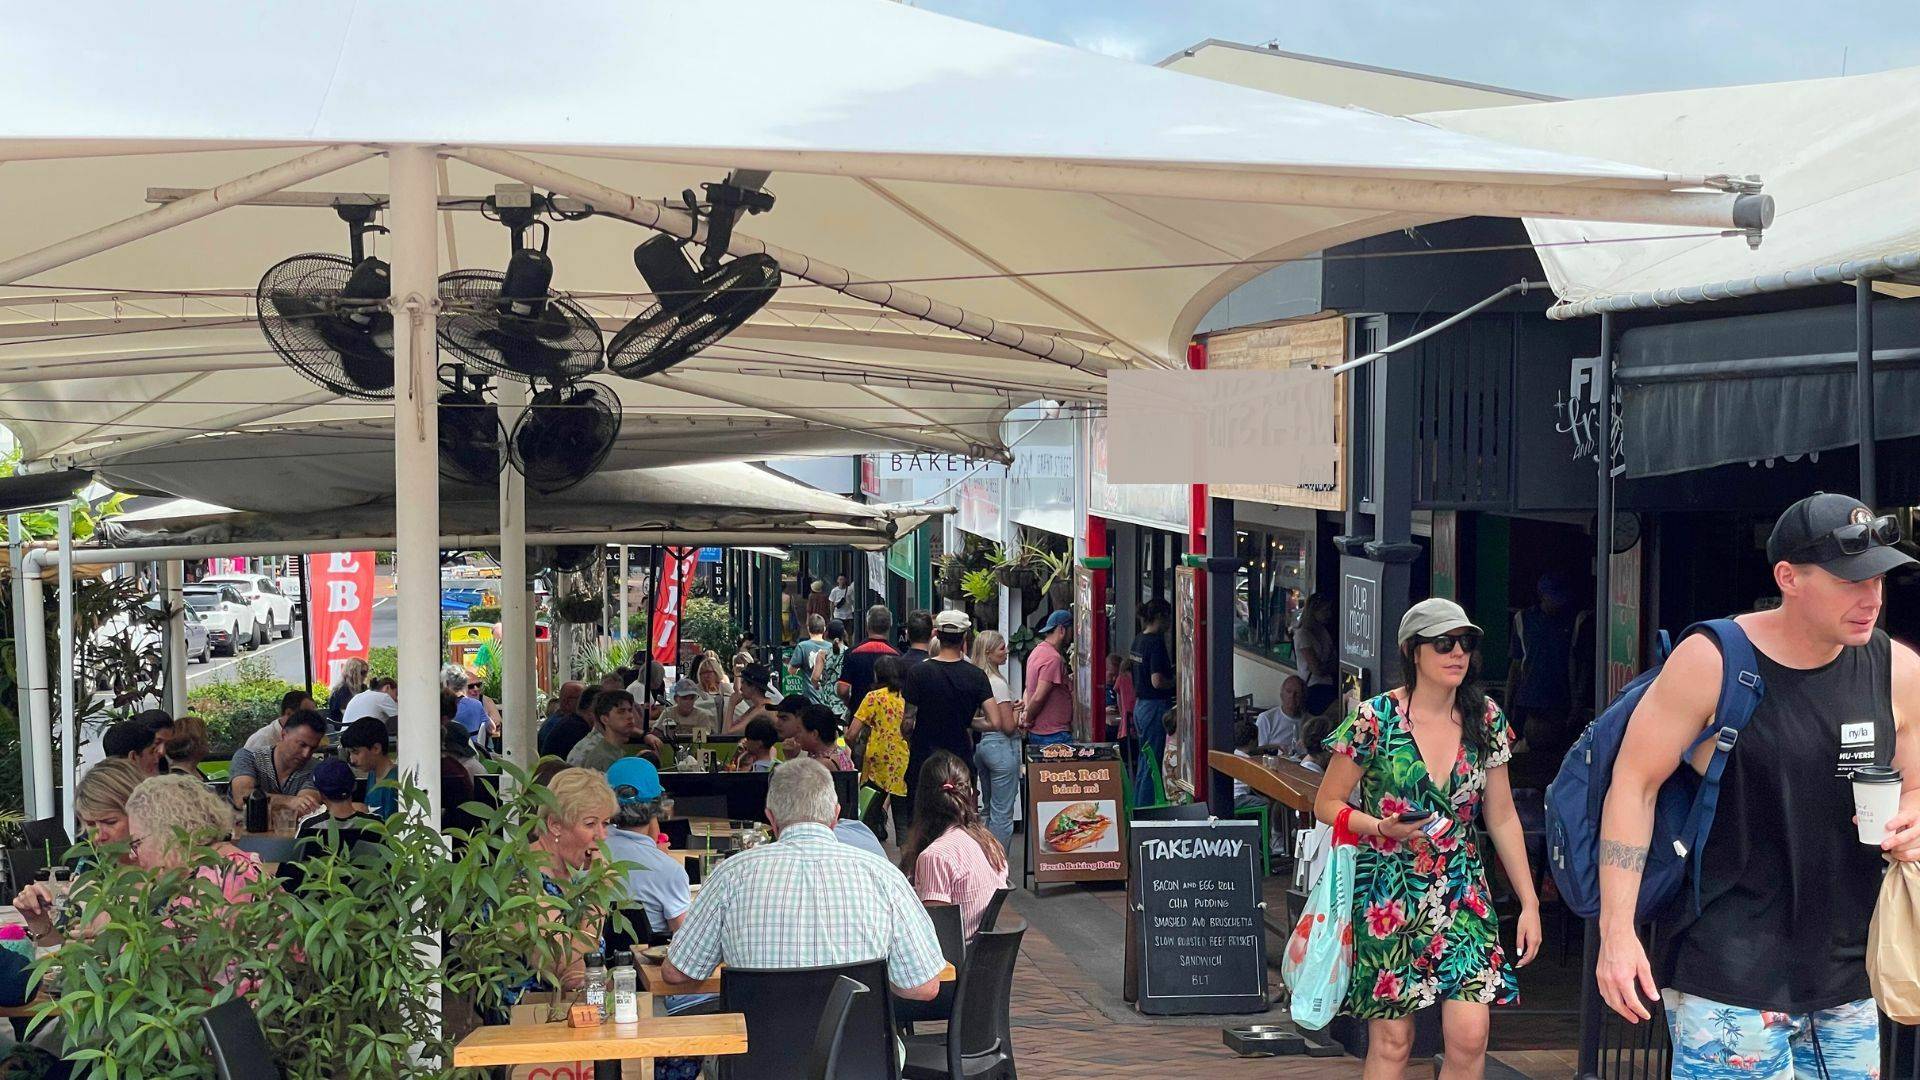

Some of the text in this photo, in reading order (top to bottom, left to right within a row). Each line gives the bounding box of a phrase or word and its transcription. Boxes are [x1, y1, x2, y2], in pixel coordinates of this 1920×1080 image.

[1352, 584, 1368, 611] OUR
[1040, 769, 1110, 782] Pork Roll
[1142, 838, 1243, 860] TAKEAWAY
[1040, 860, 1121, 871] Fresh Baking Daily
[1153, 880, 1179, 891] BACON
[1199, 880, 1215, 891] EGG
[1218, 881, 1235, 891] ROLL
[1169, 898, 1229, 909] CHIA PUDDING
[1154, 916, 1253, 928] SMASHED AVO BRUSCHETTA
[1155, 935, 1255, 947] SLOW ROASTED BEEF BRISKET
[1180, 955, 1222, 967] SANDWICH
[1191, 975, 1209, 985] BLT
[581, 1011, 593, 1022] 11
